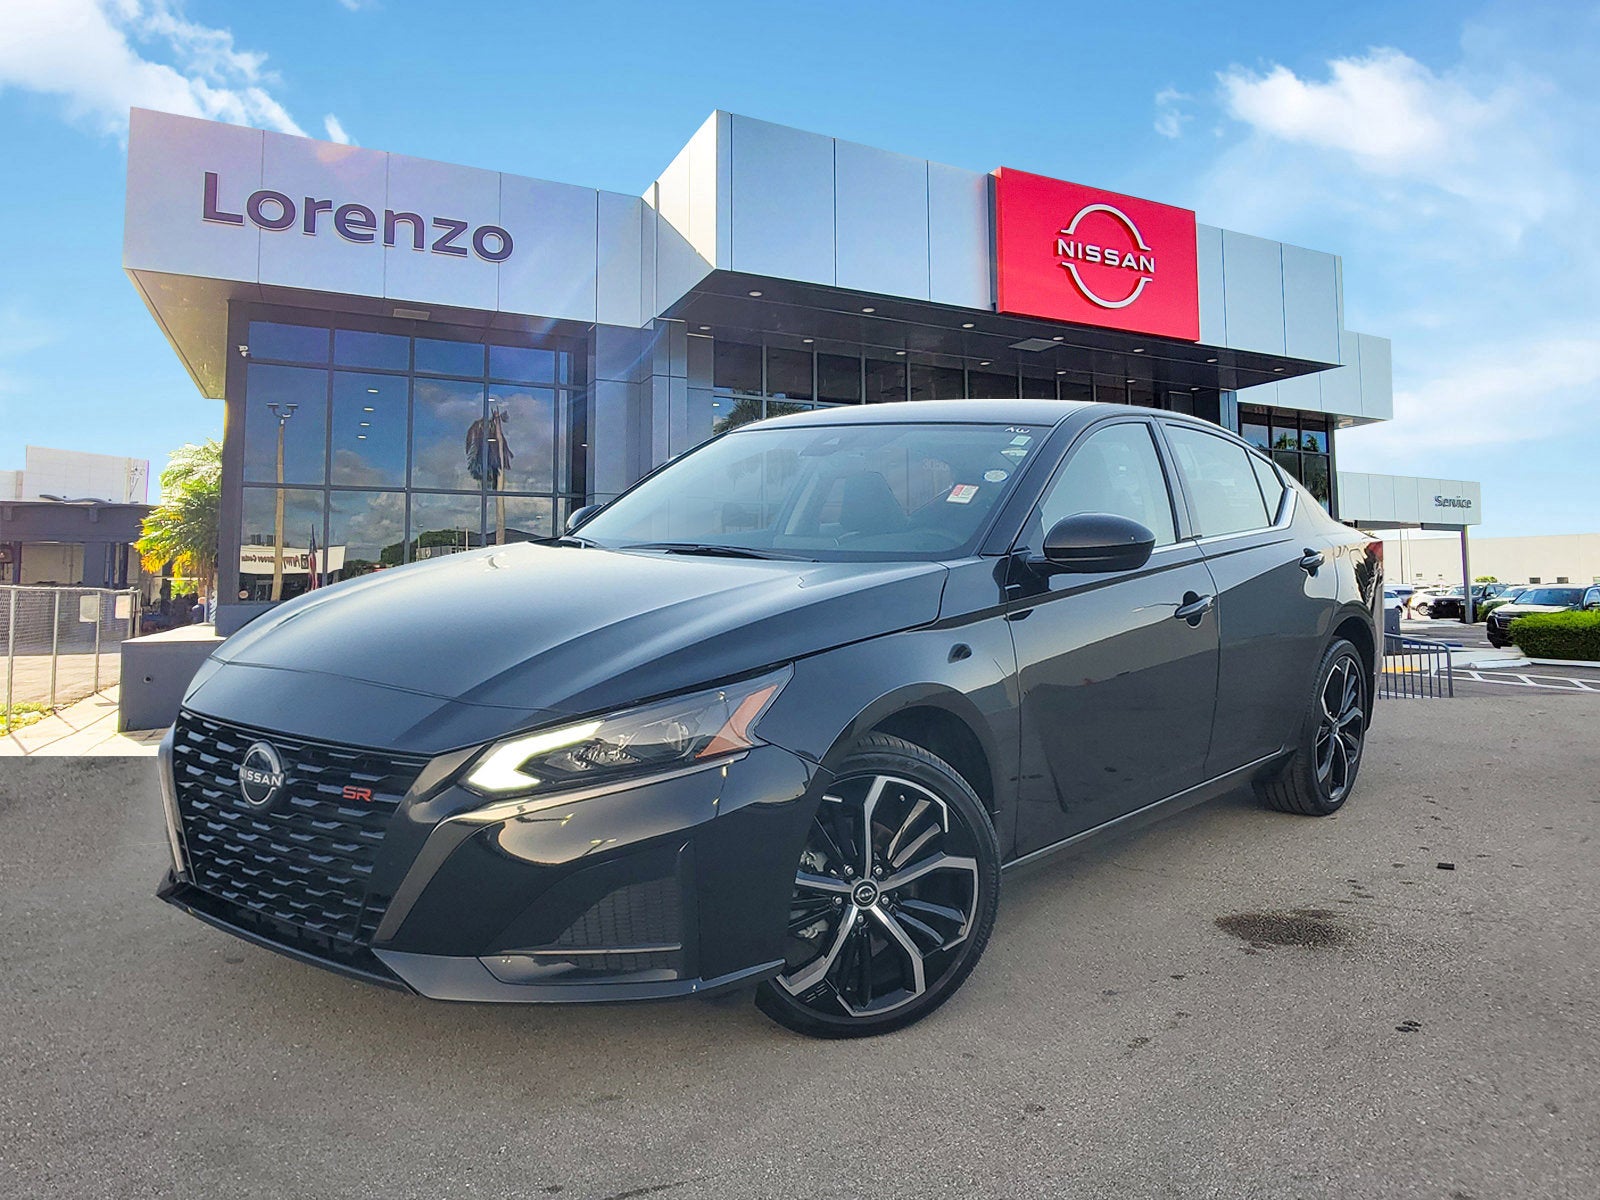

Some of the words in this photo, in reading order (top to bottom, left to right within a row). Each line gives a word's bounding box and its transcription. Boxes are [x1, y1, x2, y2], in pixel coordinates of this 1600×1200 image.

[202, 170, 515, 263] Lorenzo
[1057, 238, 1155, 273] NISSAN
[1434, 495, 1472, 508] Service
[240, 767, 284, 787] NISSAN
[342, 785, 372, 802] SR
